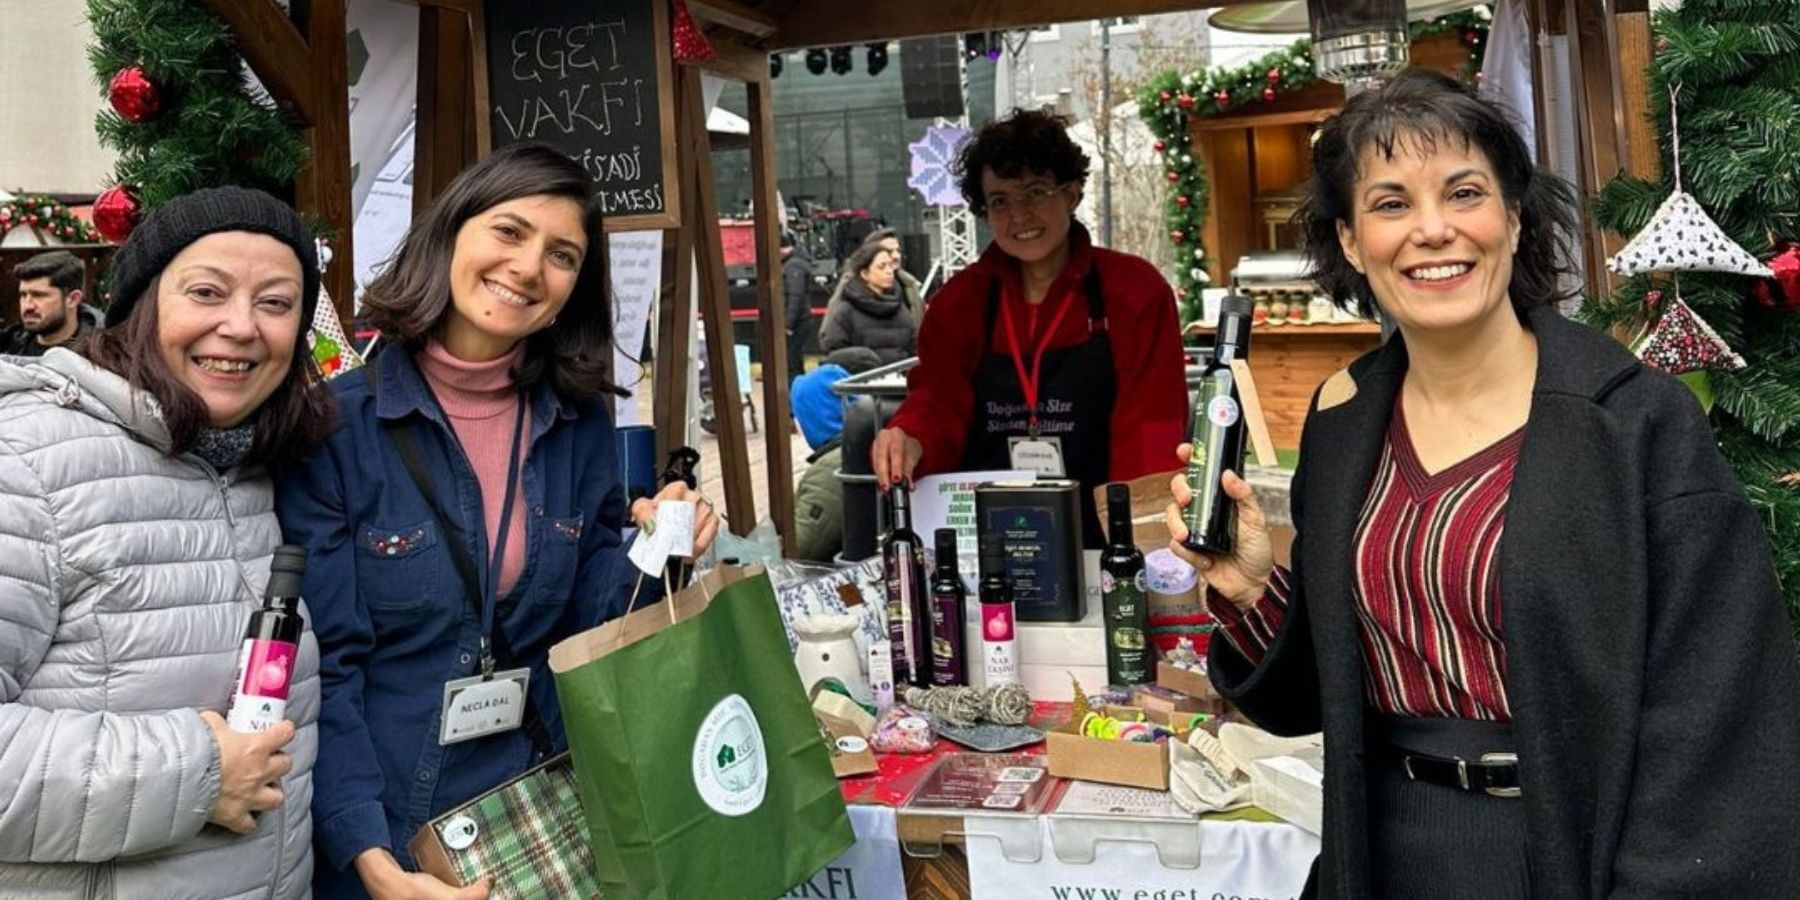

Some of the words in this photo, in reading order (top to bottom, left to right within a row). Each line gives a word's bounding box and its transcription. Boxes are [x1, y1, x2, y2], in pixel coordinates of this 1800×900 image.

[512, 17, 626, 82] EGET
[495, 77, 643, 139] VAKFI
[461, 699, 490, 713] NECLA
[492, 697, 509, 707] DAL
